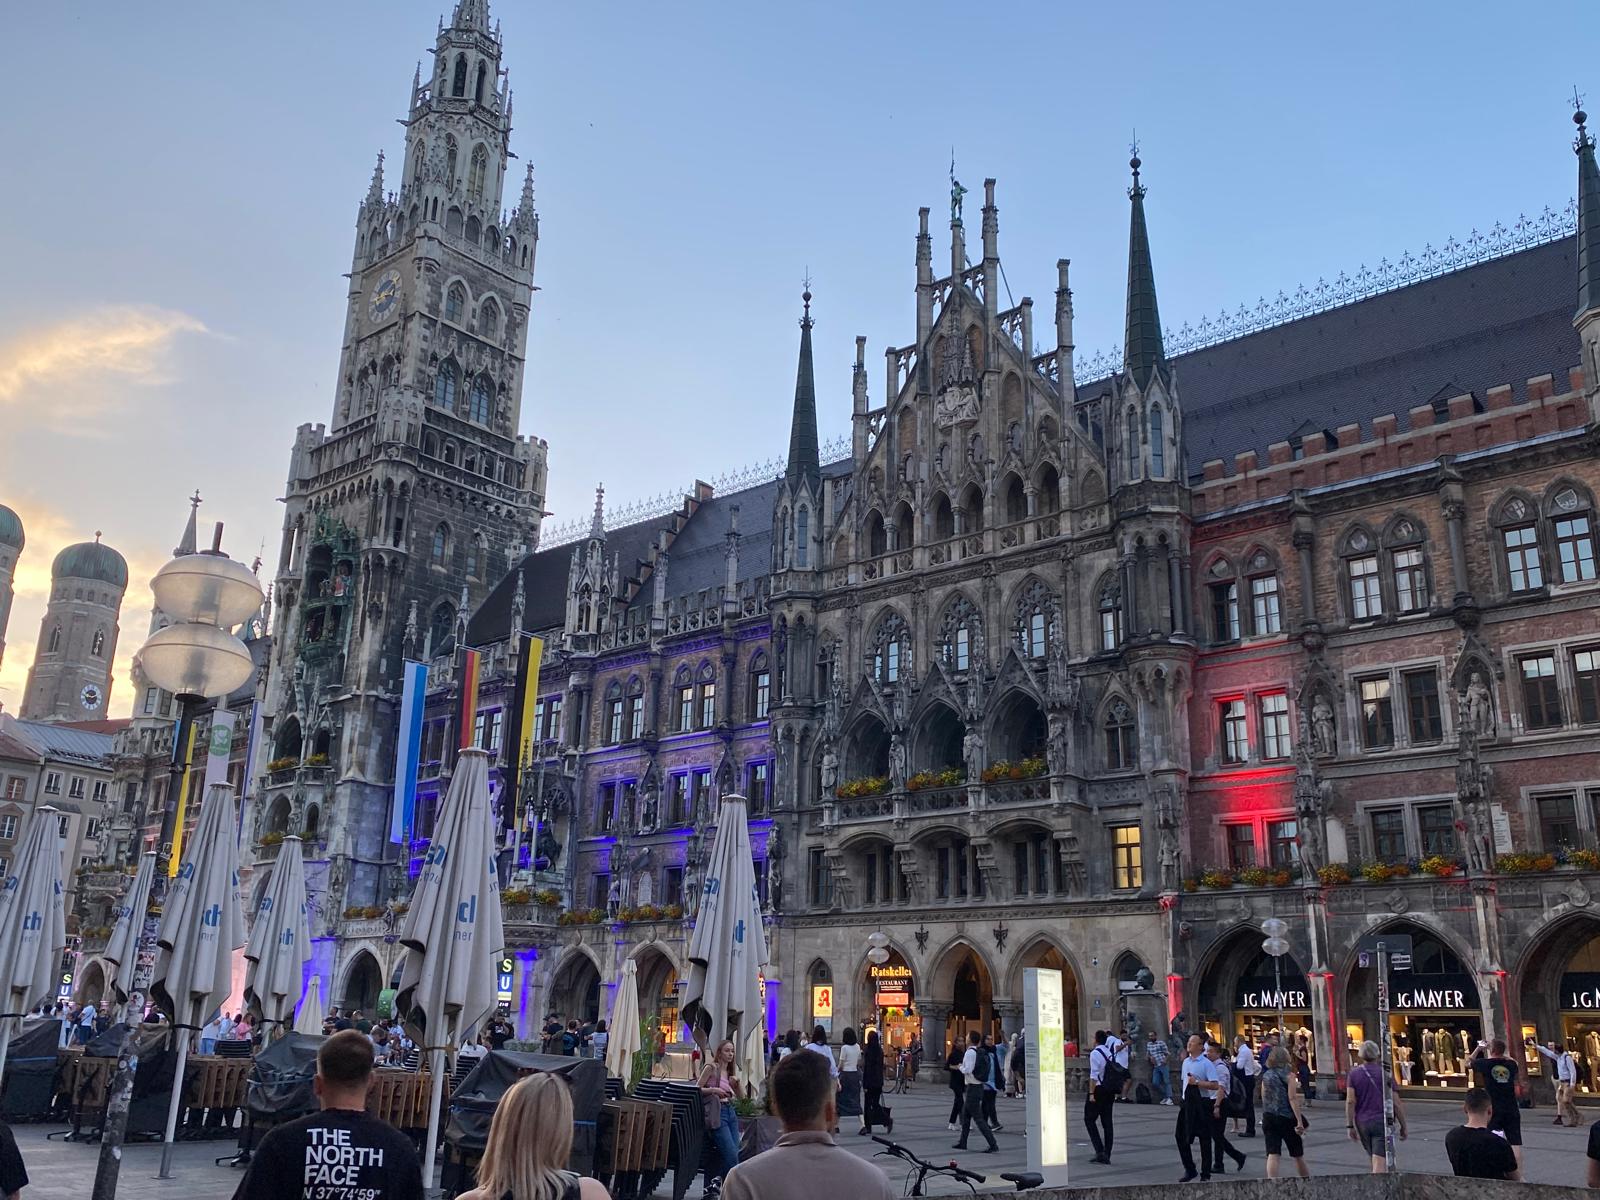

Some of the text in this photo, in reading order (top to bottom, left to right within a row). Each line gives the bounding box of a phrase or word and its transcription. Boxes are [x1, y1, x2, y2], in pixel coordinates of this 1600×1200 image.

[502, 958, 512, 972] S
[63, 973, 72, 984] S
[501, 976, 510, 989] U
[61, 985, 69, 995] U
[1261, 989, 1305, 1007] MAYER
[1414, 988, 1464, 1007] MAYER
[306, 1128, 351, 1146] THE
[306, 1145, 383, 1167] NORTH
[304, 1164, 360, 1185] FACE
